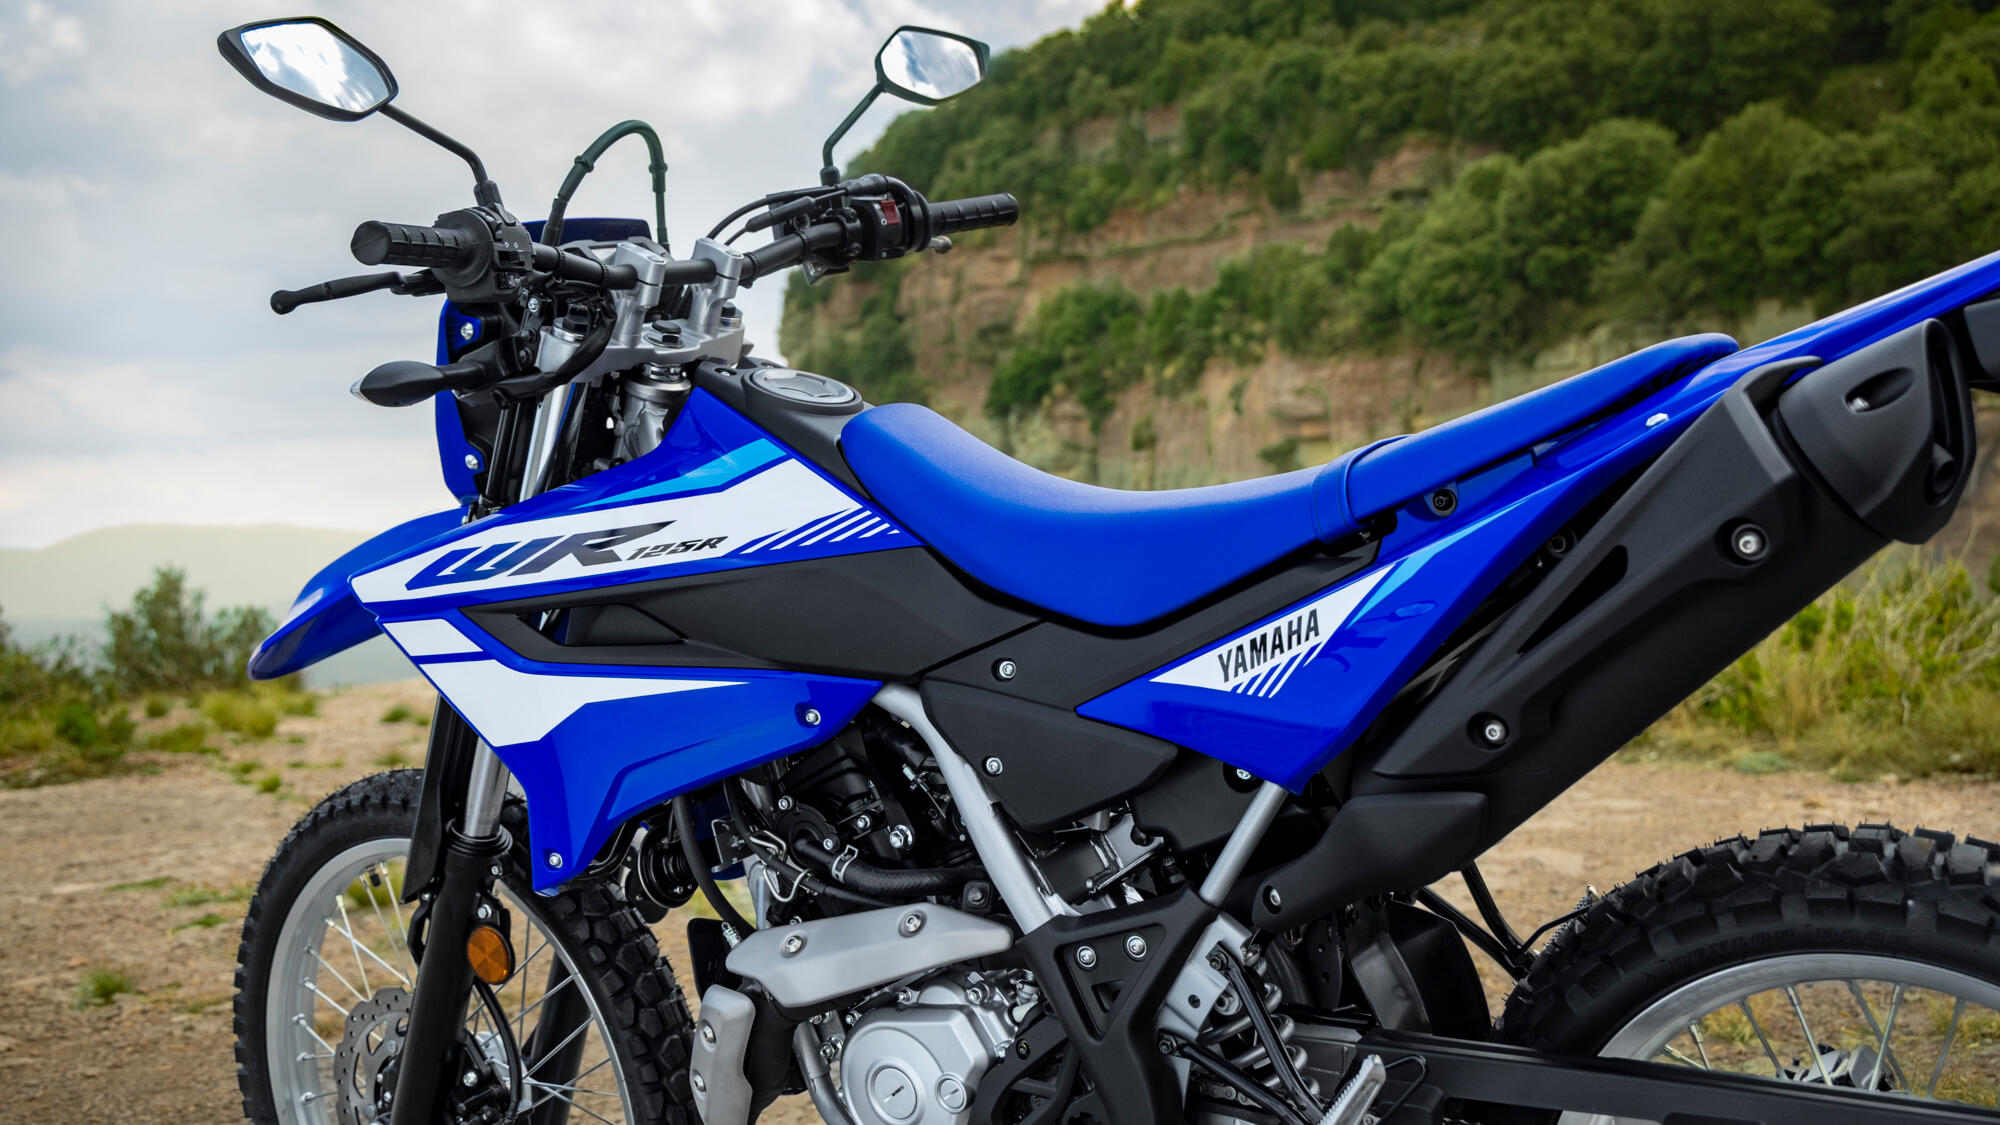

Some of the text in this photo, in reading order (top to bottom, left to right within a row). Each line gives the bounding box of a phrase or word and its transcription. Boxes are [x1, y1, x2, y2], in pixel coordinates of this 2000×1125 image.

[404, 519, 729, 591] WR 125R
[1217, 607, 1320, 683] YAMAHA
